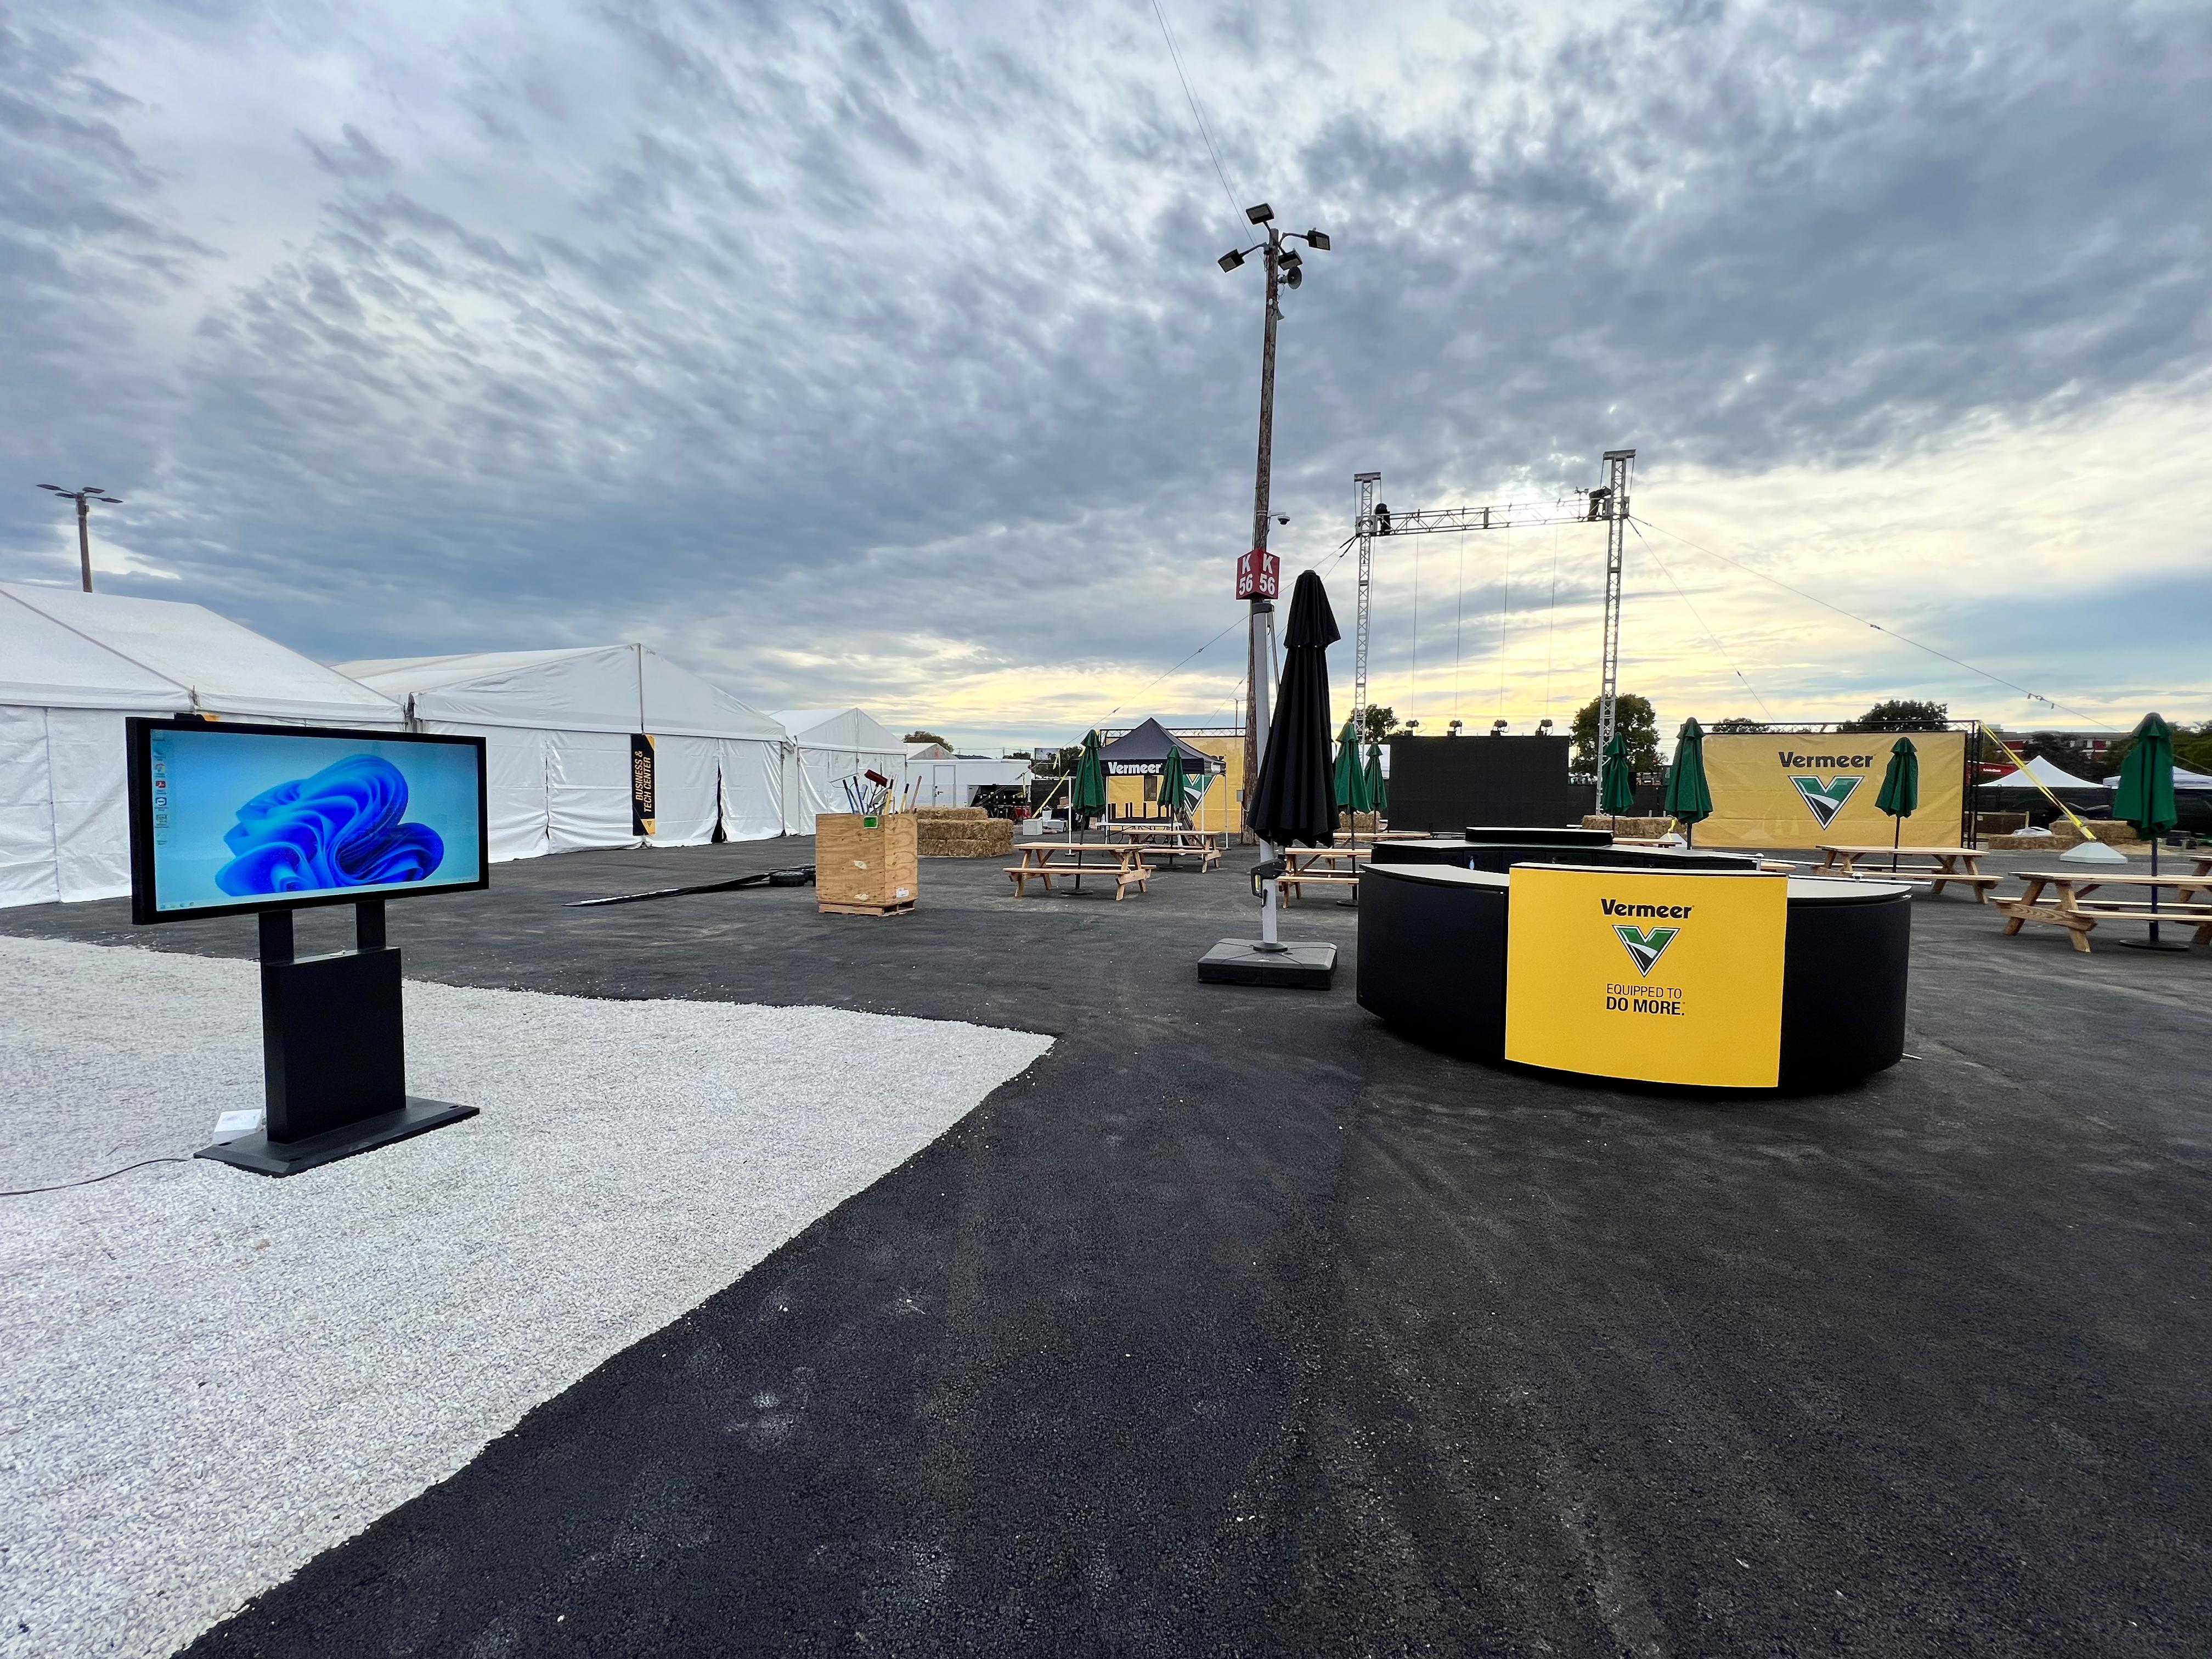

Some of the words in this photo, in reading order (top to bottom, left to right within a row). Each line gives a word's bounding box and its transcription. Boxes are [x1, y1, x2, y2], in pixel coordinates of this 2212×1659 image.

[1242, 553, 1251, 574] K
[1262, 552, 1273, 574] K
[1239, 573, 1253, 595] 56
[1259, 573, 1275, 595] 56
[1108, 761, 1161, 774] Vermeer
[1778, 751, 1874, 768] Vermeer
[634, 759, 643, 801] BUSINESS
[643, 757, 651, 789] CENTER
[644, 791, 652, 812] TECH
[1600, 898, 1692, 919] Vermeer
[1606, 983, 1663, 997] EQUIPPED
[1667, 988, 1682, 999] TO
[1606, 996, 1628, 1011] DO
[1633, 998, 1685, 1015] MORE.
